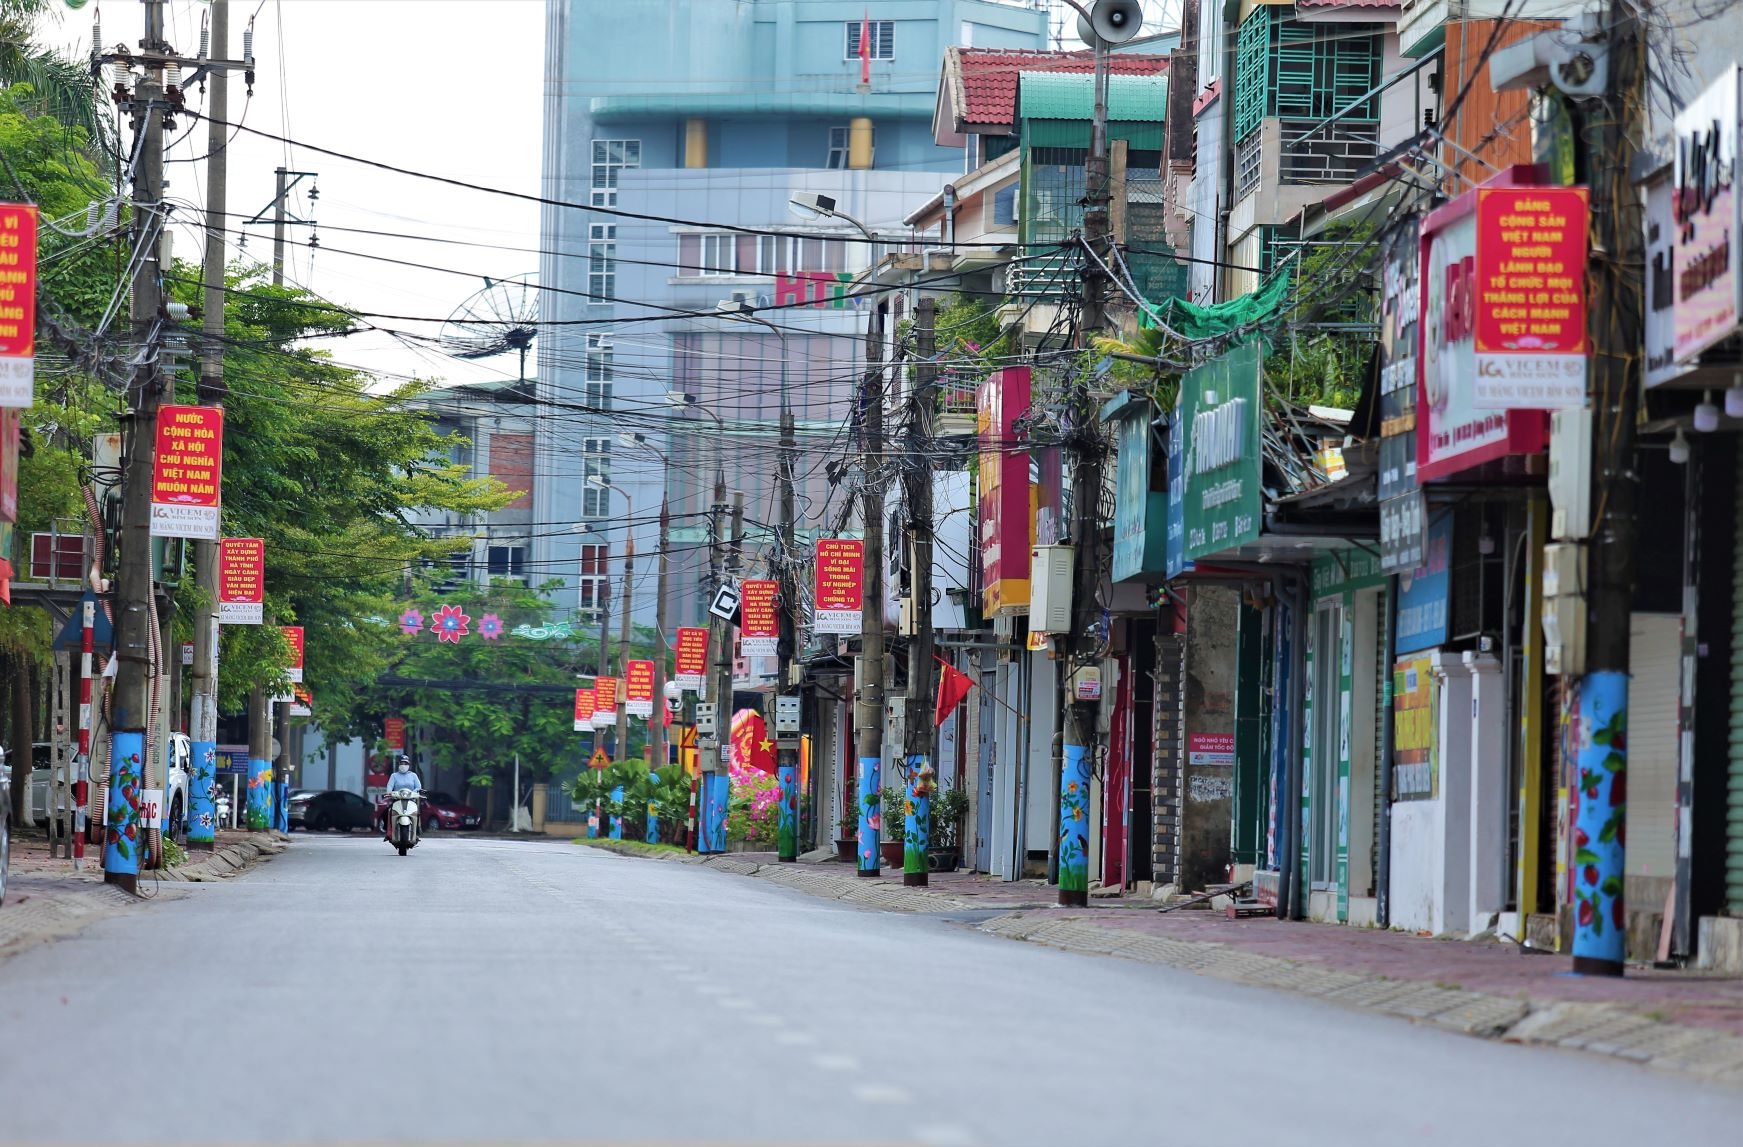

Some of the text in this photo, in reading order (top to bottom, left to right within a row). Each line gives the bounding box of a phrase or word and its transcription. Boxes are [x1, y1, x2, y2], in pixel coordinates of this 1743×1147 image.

[1499, 215, 1535, 228] CỘNG
[1502, 230, 1562, 244] VIỆT NAM
[1492, 306, 1527, 319] CÁCH
[1500, 322, 1561, 336] VIỆT NAM
[1505, 360, 1559, 371] VICEM
[176, 412, 204, 424] NƯỚC
[164, 426, 214, 438] CỘNG HÒA
[171, 441, 205, 453] XÃ HỘI
[160, 452, 214, 467] CHỦ NGHĨA
[163, 468, 210, 480] VIỆT NAM
[157, 481, 214, 494] MUÔN NĂM
[170, 508, 202, 516] VICEM
